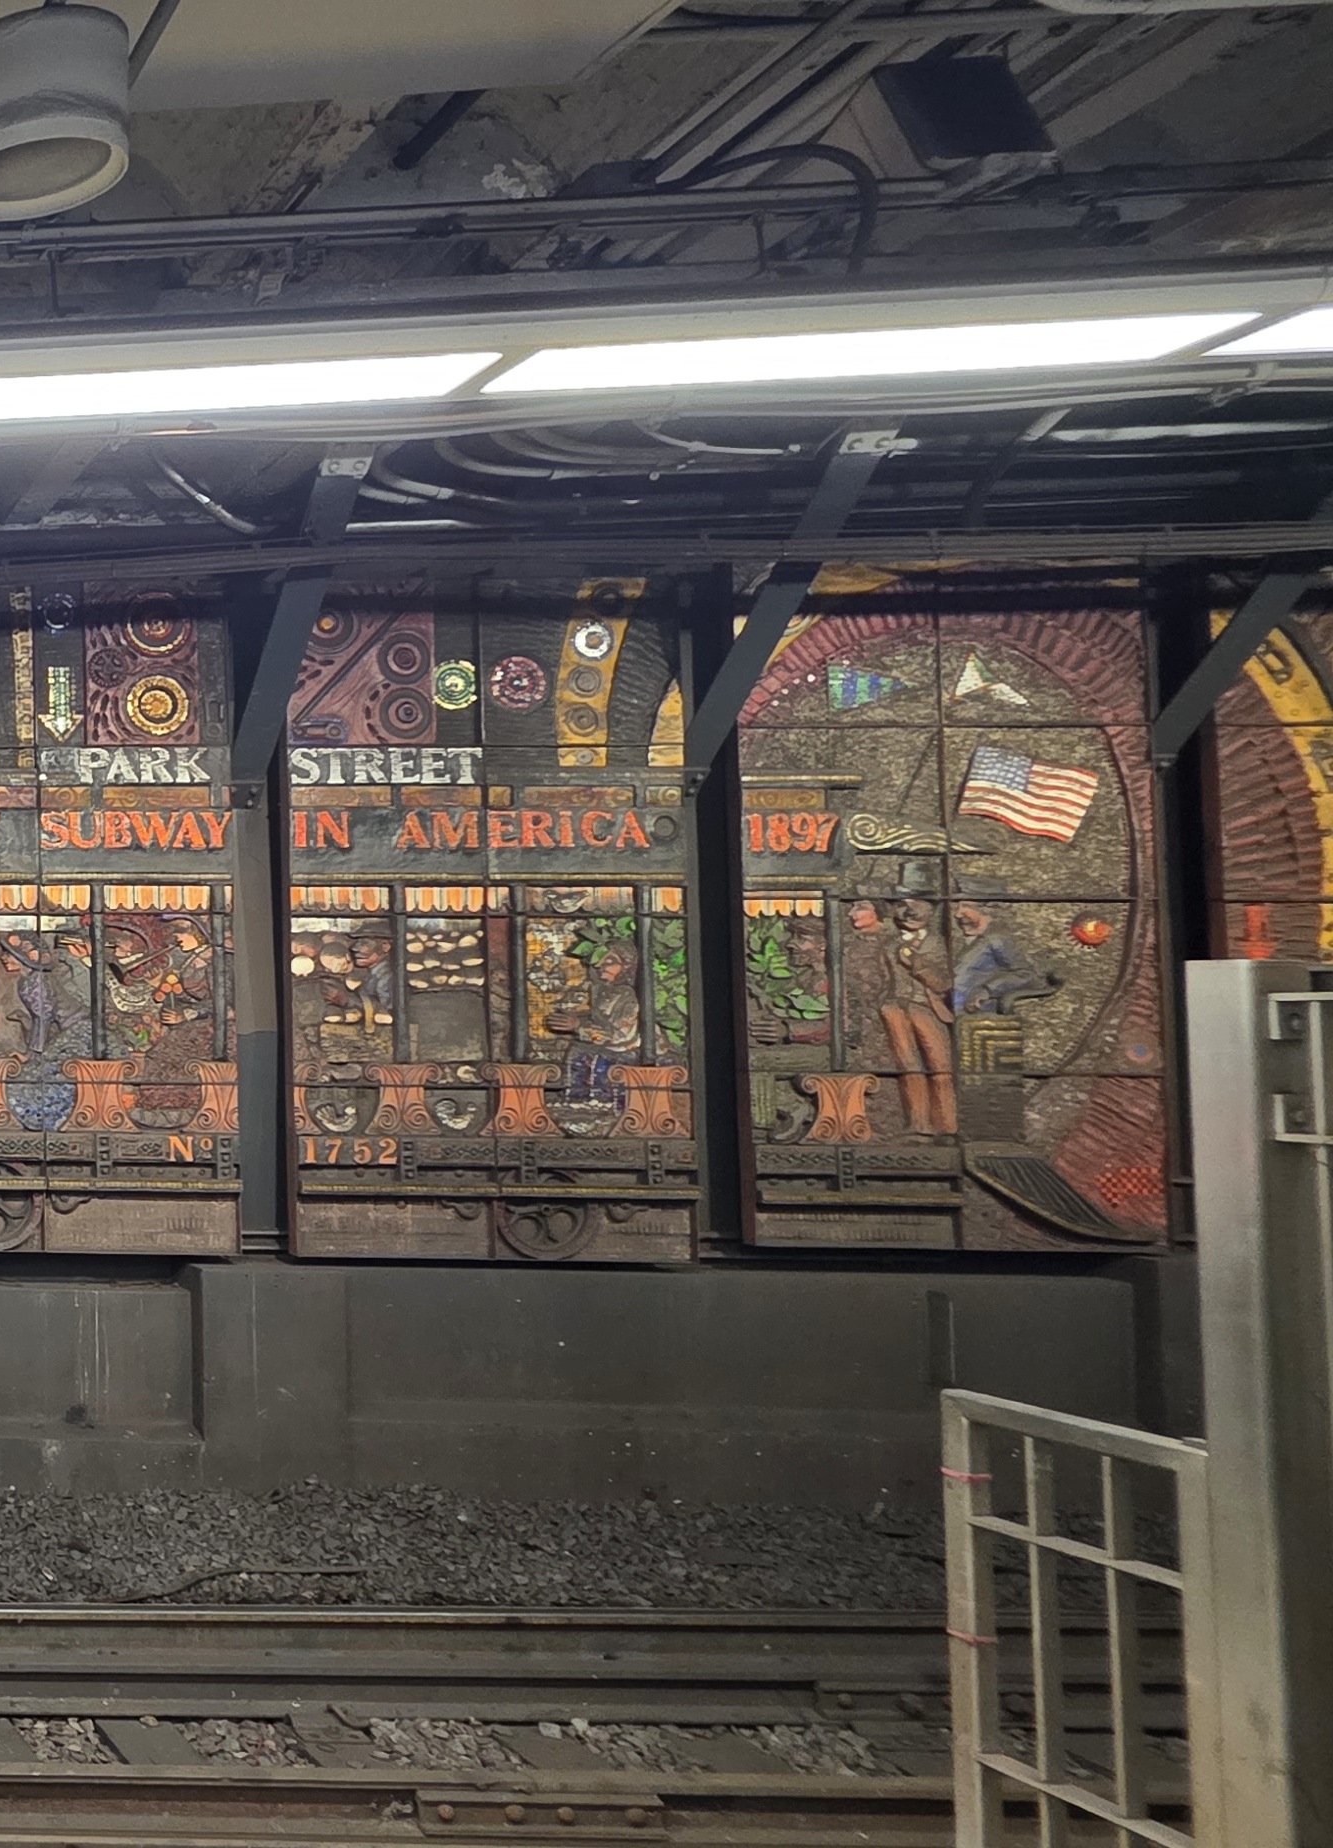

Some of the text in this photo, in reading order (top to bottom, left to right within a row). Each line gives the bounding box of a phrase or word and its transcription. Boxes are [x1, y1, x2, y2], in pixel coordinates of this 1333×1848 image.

[79, 747, 483, 784] PARK STREET
[40, 810, 233, 849] SUBWAY
[292, 811, 350, 849] IN
[396, 810, 650, 849] AMERICA
[745, 812, 839, 852] 1897
[304, 1137, 398, 1164] 1752
